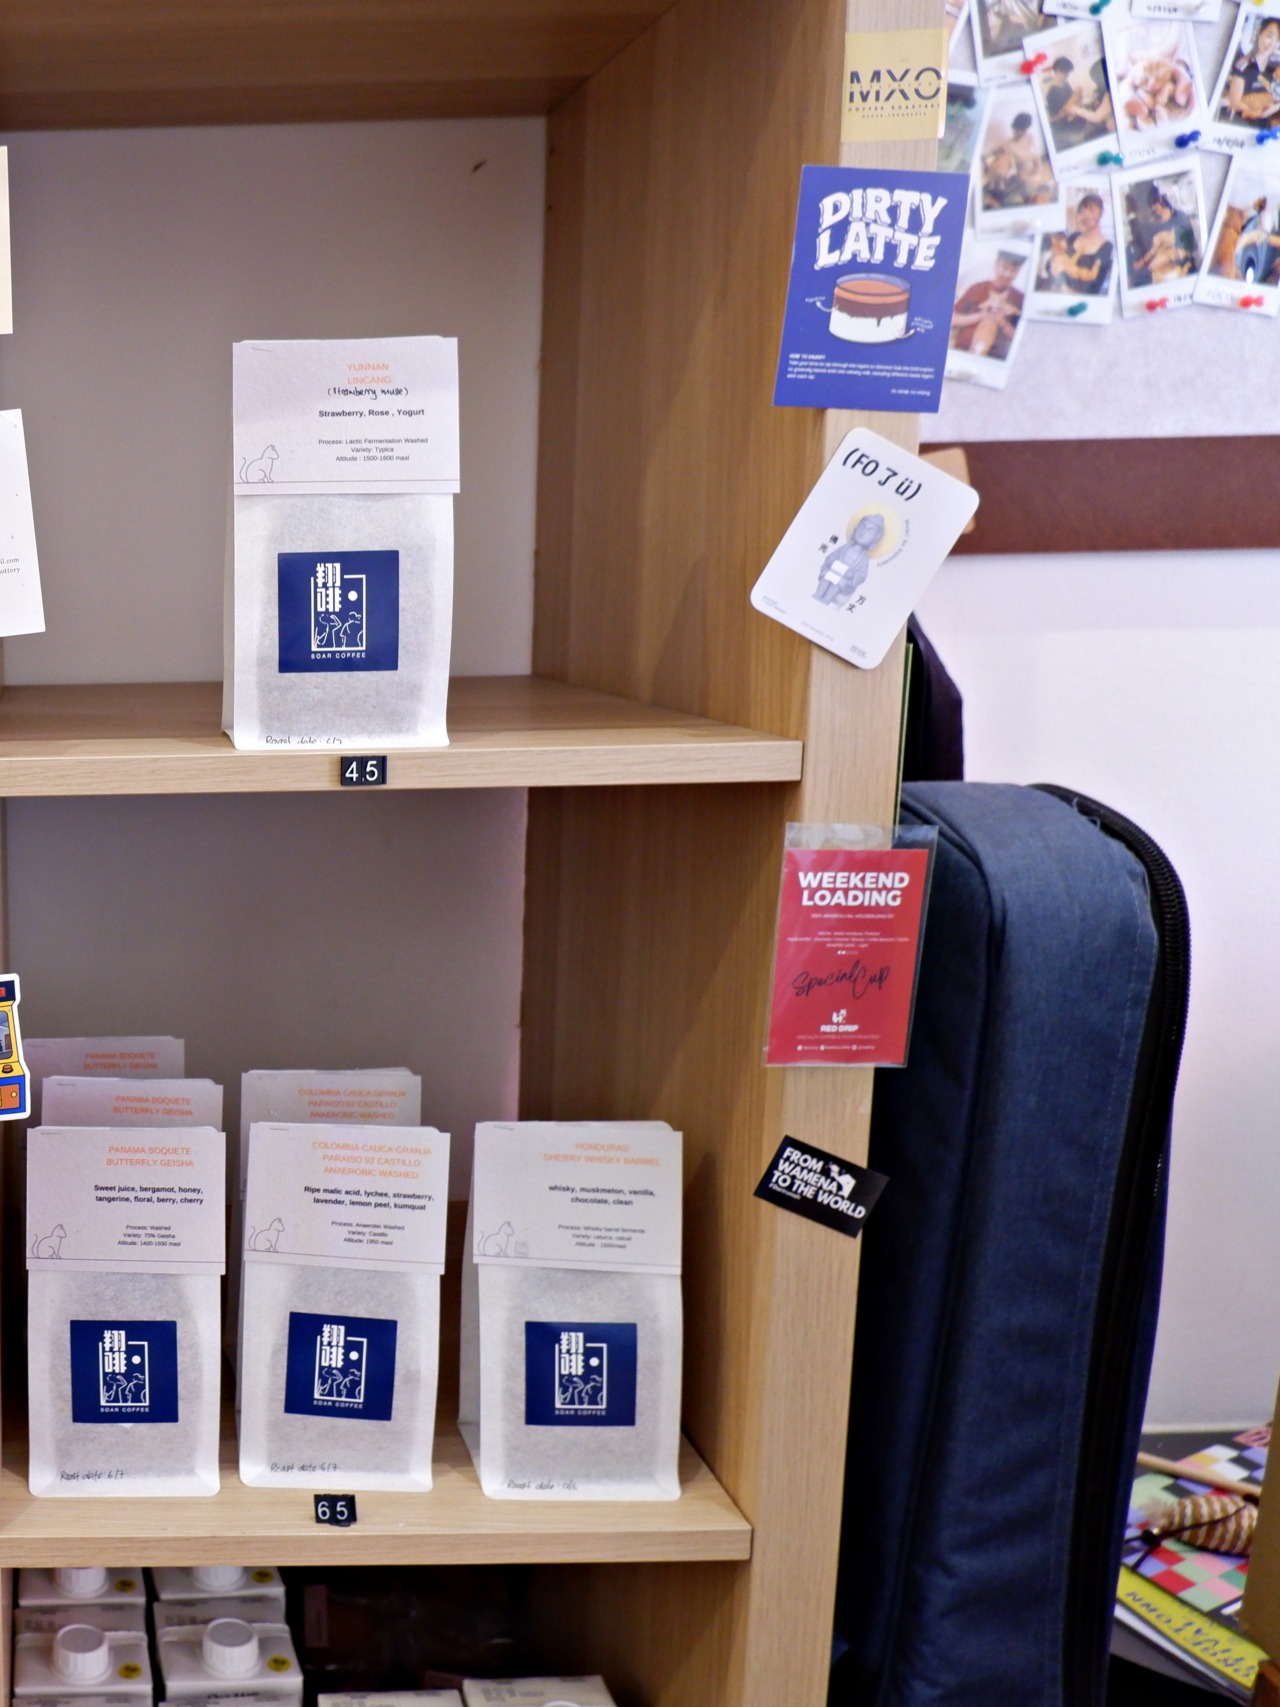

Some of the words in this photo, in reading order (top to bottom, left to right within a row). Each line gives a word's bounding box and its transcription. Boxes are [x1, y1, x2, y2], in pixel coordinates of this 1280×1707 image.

[849, 67, 941, 103] MXO
[818, 187, 947, 237] DIRTY
[814, 220, 941, 271] LATTE
[347, 363, 389, 371] YUNNAN
[347, 376, 392, 384] LINCANG
[319, 410, 366, 418] Strawberry,
[397, 409, 425, 417] Yogurt
[345, 760, 378, 781] 45
[798, 872, 910, 888] WEEKEND
[802, 890, 902, 906] LOADING
[108, 1146, 145, 1154] PANAMA
[148, 1146, 191, 1155] BOQUETE
[312, 1141, 360, 1151] COLOMBIA
[362, 1144, 393, 1153] CAUCA
[106, 1158, 157, 1166] BUTTERFLY
[160, 1159, 194, 1167] GEISHA
[377, 1157, 421, 1167] CASTILLO
[782, 1147, 824, 1172] FROM
[323, 1166, 377, 1177] ANAEROBIC
[379, 1169, 418, 1179] WASHED
[778, 1159, 838, 1194] WAMENA
[118, 1185, 137, 1193] juice,
[304, 1186, 321, 1194] Ripe
[364, 1190, 390, 1198] lychee,
[393, 1192, 434, 1201] strawberry,
[548, 1185, 578, 1193] whisky,
[579, 1186, 627, 1195] muskmelon,
[628, 1188, 656, 1197] vanilla,
[771, 1170, 791, 1187] TO
[792, 1179, 817, 1199] THE
[816, 1190, 866, 1219] WORLD
[180, 1197, 203, 1205] cherry
[314, 1197, 347, 1206] lavender,
[571, 1196, 611, 1205] chocolate,
[318, 1501, 348, 1520] 65
